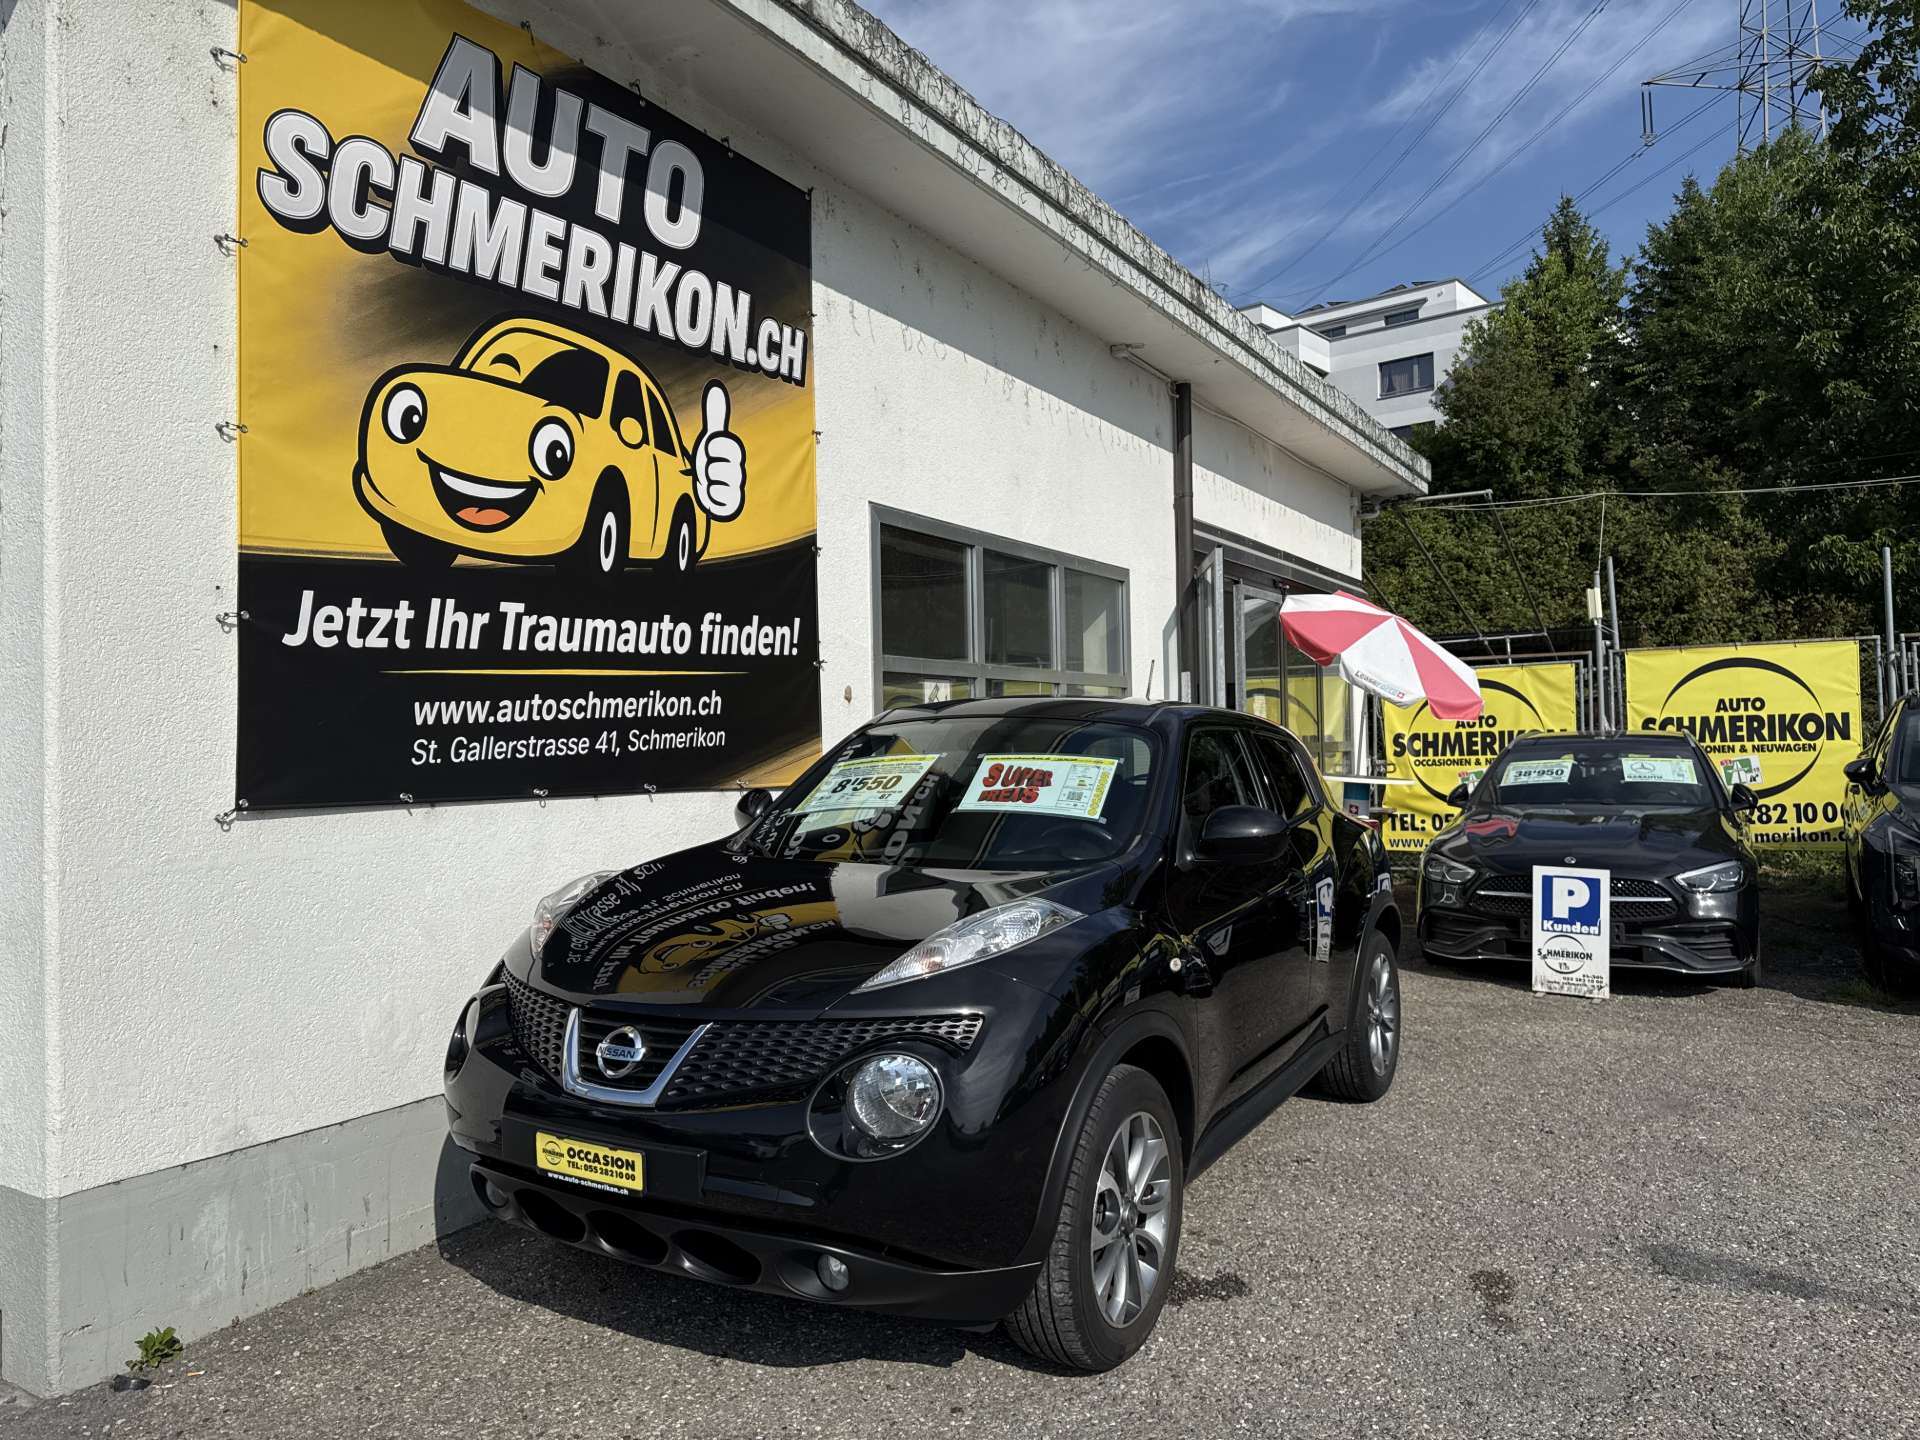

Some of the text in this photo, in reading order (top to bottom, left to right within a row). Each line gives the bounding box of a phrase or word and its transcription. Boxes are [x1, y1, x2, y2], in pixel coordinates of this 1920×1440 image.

[411, 35, 704, 249] AUTO
[259, 110, 806, 382] SCHMERIKON.CH
[282, 590, 800, 656] Jetzt Ihr Traumauto finden!
[413, 690, 722, 725] www.autoschmerikon.ch
[1715, 697, 1766, 713] AUTO
[411, 727, 726, 765] St. Gallerstrasse 41, Schmerikon
[1739, 745, 1748, 753] &
[1752, 743, 1817, 753] NEUWAGEN
[1414, 758, 1471, 767] OCCASIONEN
[1475, 758, 1482, 766] &
[1514, 768, 1565, 778] 38'950
[831, 774, 903, 794] 8'550
[982, 763, 1054, 788] SUPER
[1388, 813, 1427, 832] TEL:
[1793, 802, 1818, 824] 10
[1552, 877, 1590, 918] P
[1543, 919, 1600, 934] Kunden
[1537, 948, 1593, 961] SHMERIKON
[600, 1046, 636, 1060] NISSAN
[566, 1147, 636, 1172] OCCASION
